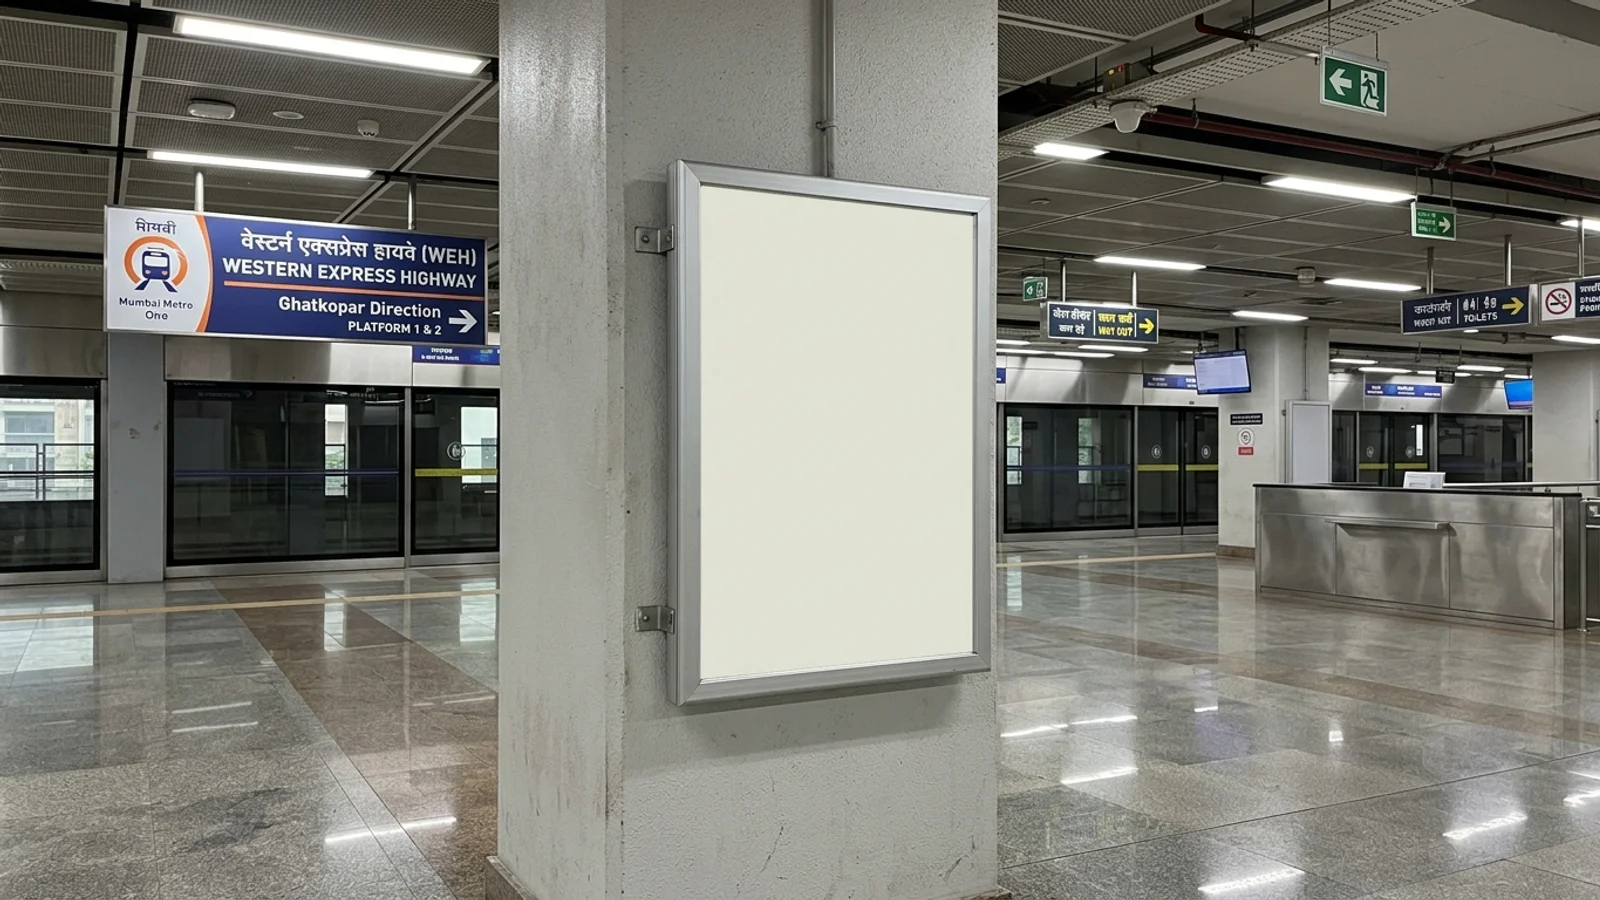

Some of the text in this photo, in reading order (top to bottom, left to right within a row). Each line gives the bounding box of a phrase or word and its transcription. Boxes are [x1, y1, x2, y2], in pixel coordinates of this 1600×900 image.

[240, 227, 477, 267] वेस्टर्न एक्सप्रेस हायवे (WEH)
[222, 257, 477, 288] WESTERN EXPRESS HIGHWAY
[119, 297, 193, 310] Mumbai Metro
[278, 296, 441, 318] Ghatkopar Direction
[145, 310, 168, 320] One
[348, 321, 442, 335] PLATFORM 1 & 2
